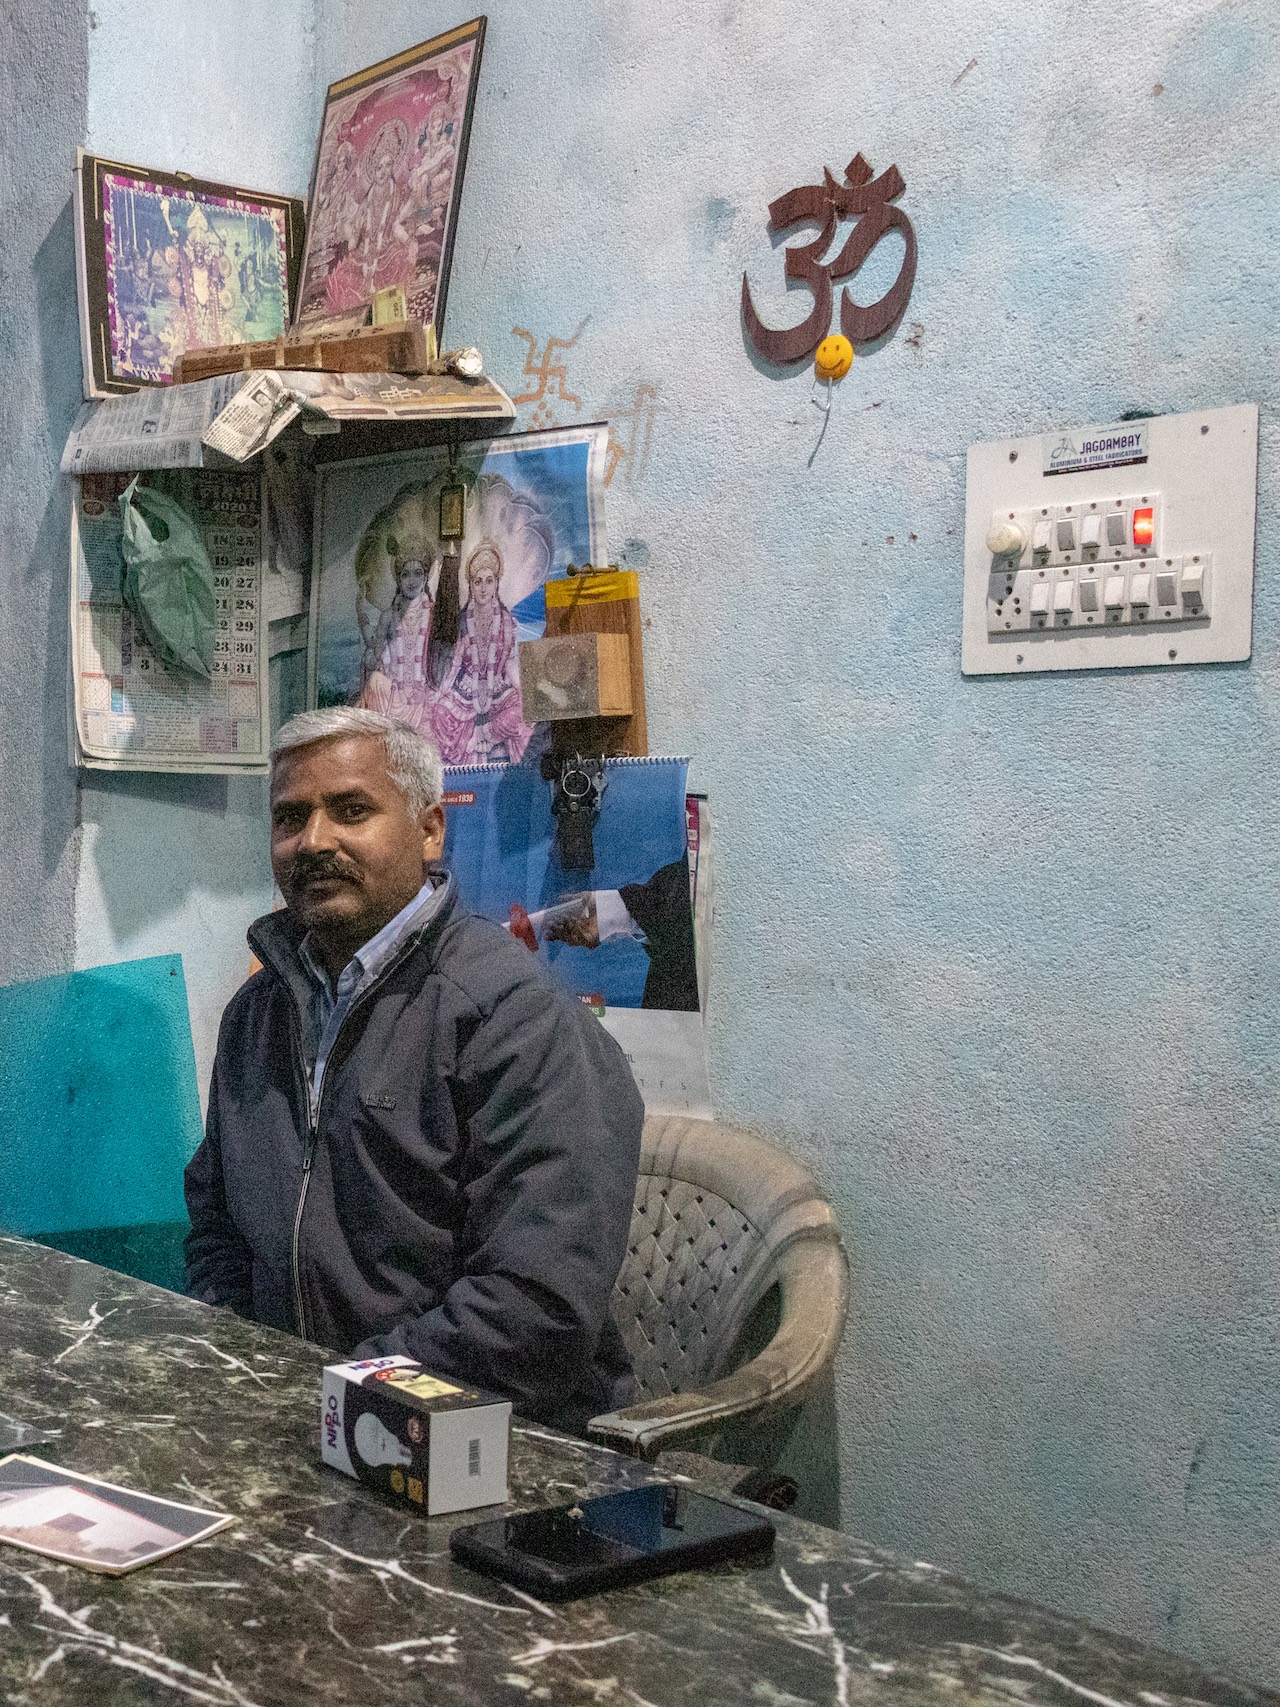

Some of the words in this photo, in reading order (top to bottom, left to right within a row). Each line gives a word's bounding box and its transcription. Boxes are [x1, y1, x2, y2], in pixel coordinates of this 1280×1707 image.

[1080, 433, 1141, 454] JAGDAMBAY
[1050, 458, 1082, 469] ALUMINIUM
[1089, 454, 1103, 463] STEEL
[1105, 449, 1143, 460] FABRICATORS
[213, 535, 229, 546] 18
[236, 535, 254, 547] 25
[214, 556, 229, 567] 19
[236, 556, 255, 567] 26
[236, 577, 255, 589] 27
[235, 599, 255, 610] 28
[235, 620, 254, 632] 29
[236, 642, 253, 654] 30
[140, 659, 150, 671] 3
[212, 662, 229, 673] 24
[236, 663, 252, 674] 31
[639, 1078, 645, 1087] T
[681, 1082, 687, 1091] S
[324, 1395, 341, 1449] NIPPO
